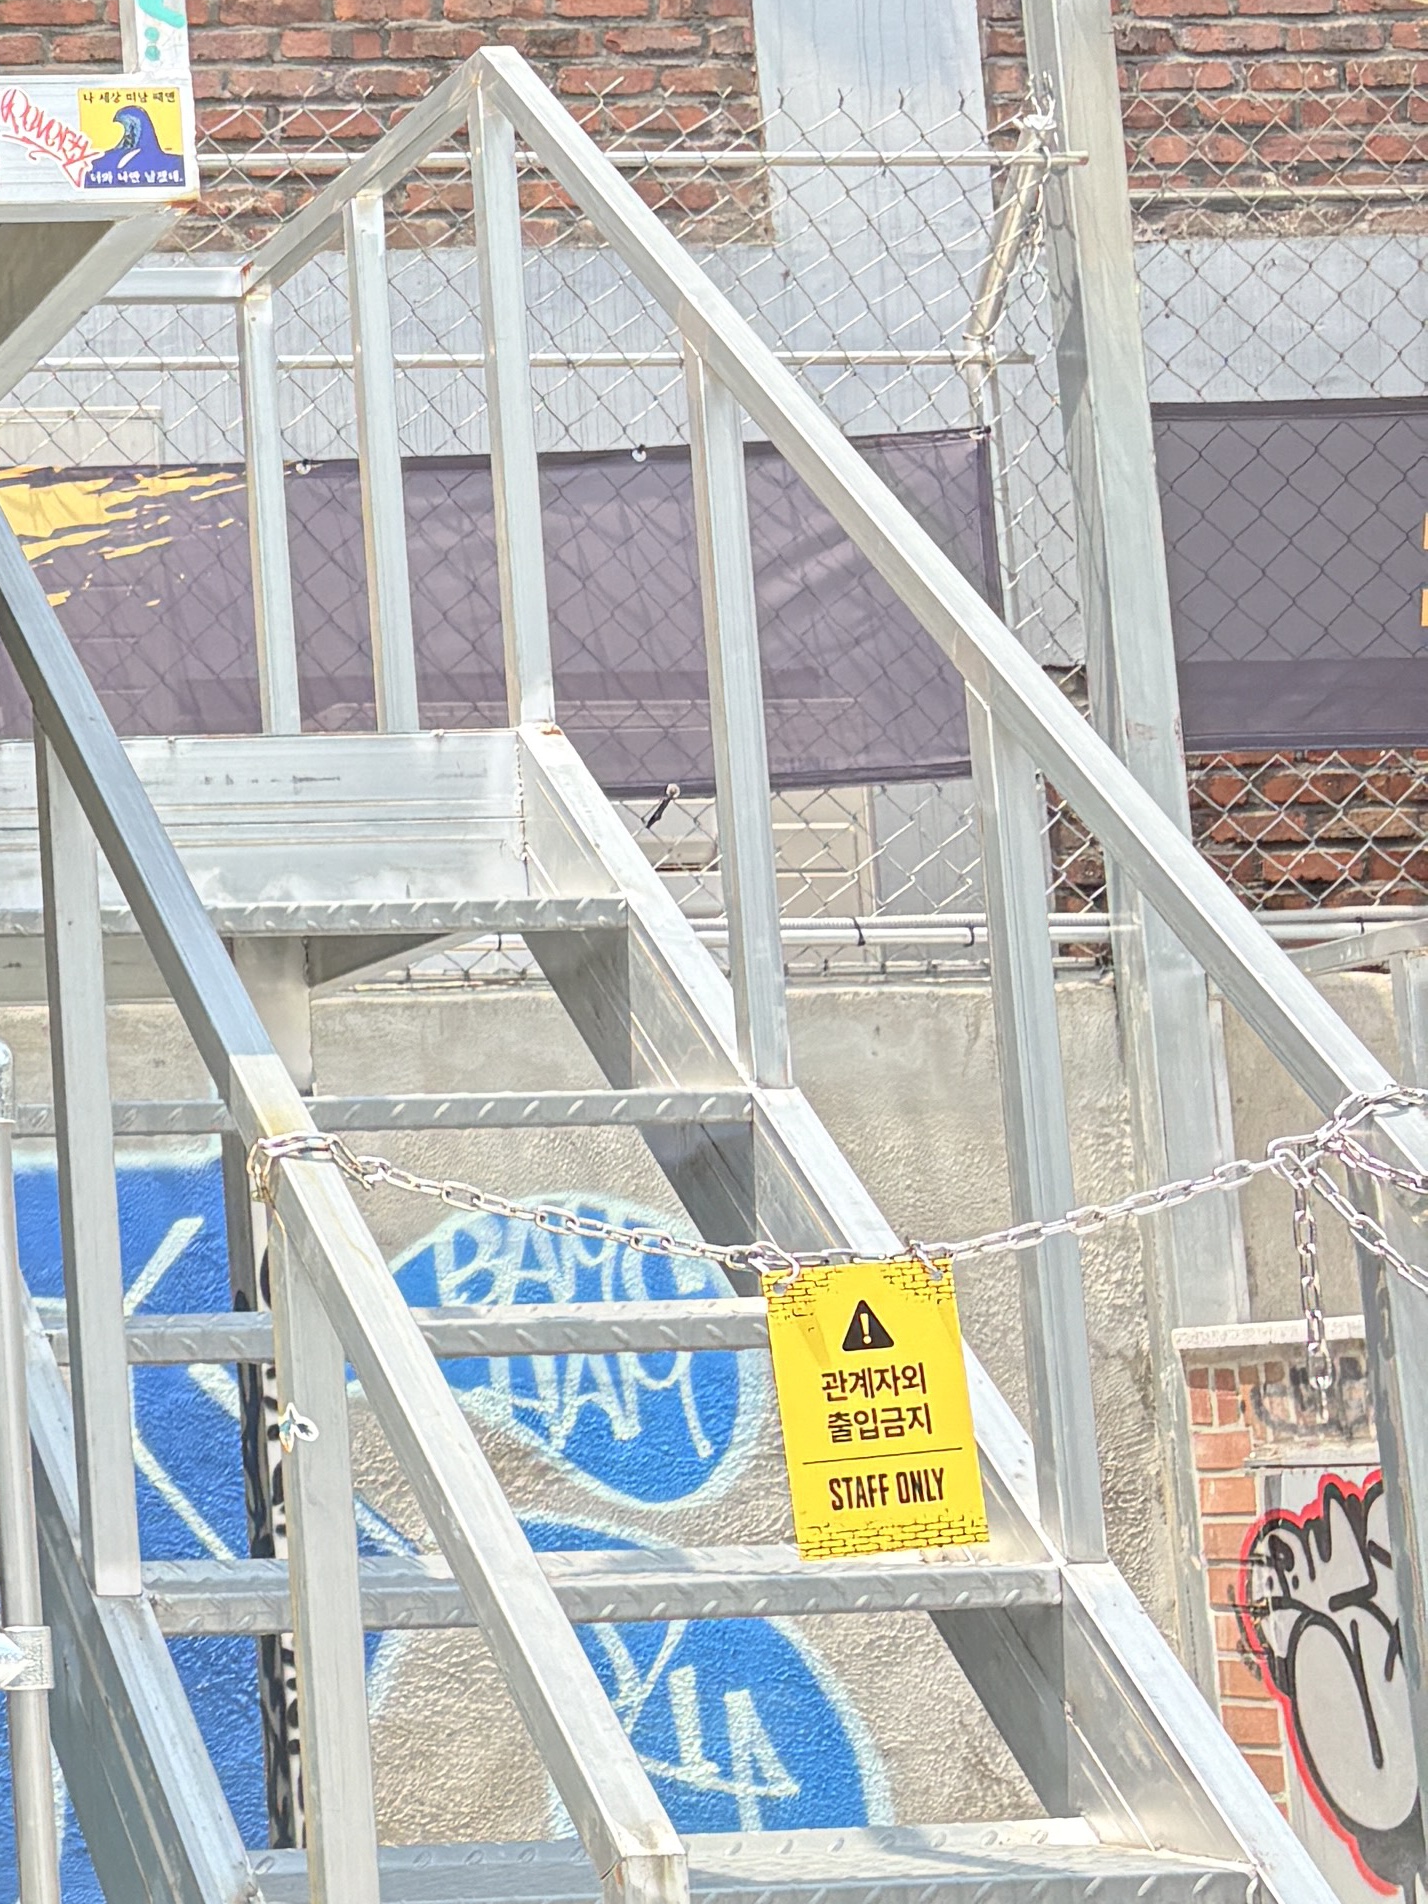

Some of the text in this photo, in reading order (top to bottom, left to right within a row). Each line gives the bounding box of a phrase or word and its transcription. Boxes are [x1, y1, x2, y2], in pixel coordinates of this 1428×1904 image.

[821, 1362, 927, 1403] 관계자외
[827, 1403, 934, 1444] 출입금지
[829, 1466, 945, 1512] STAFF ONLY
